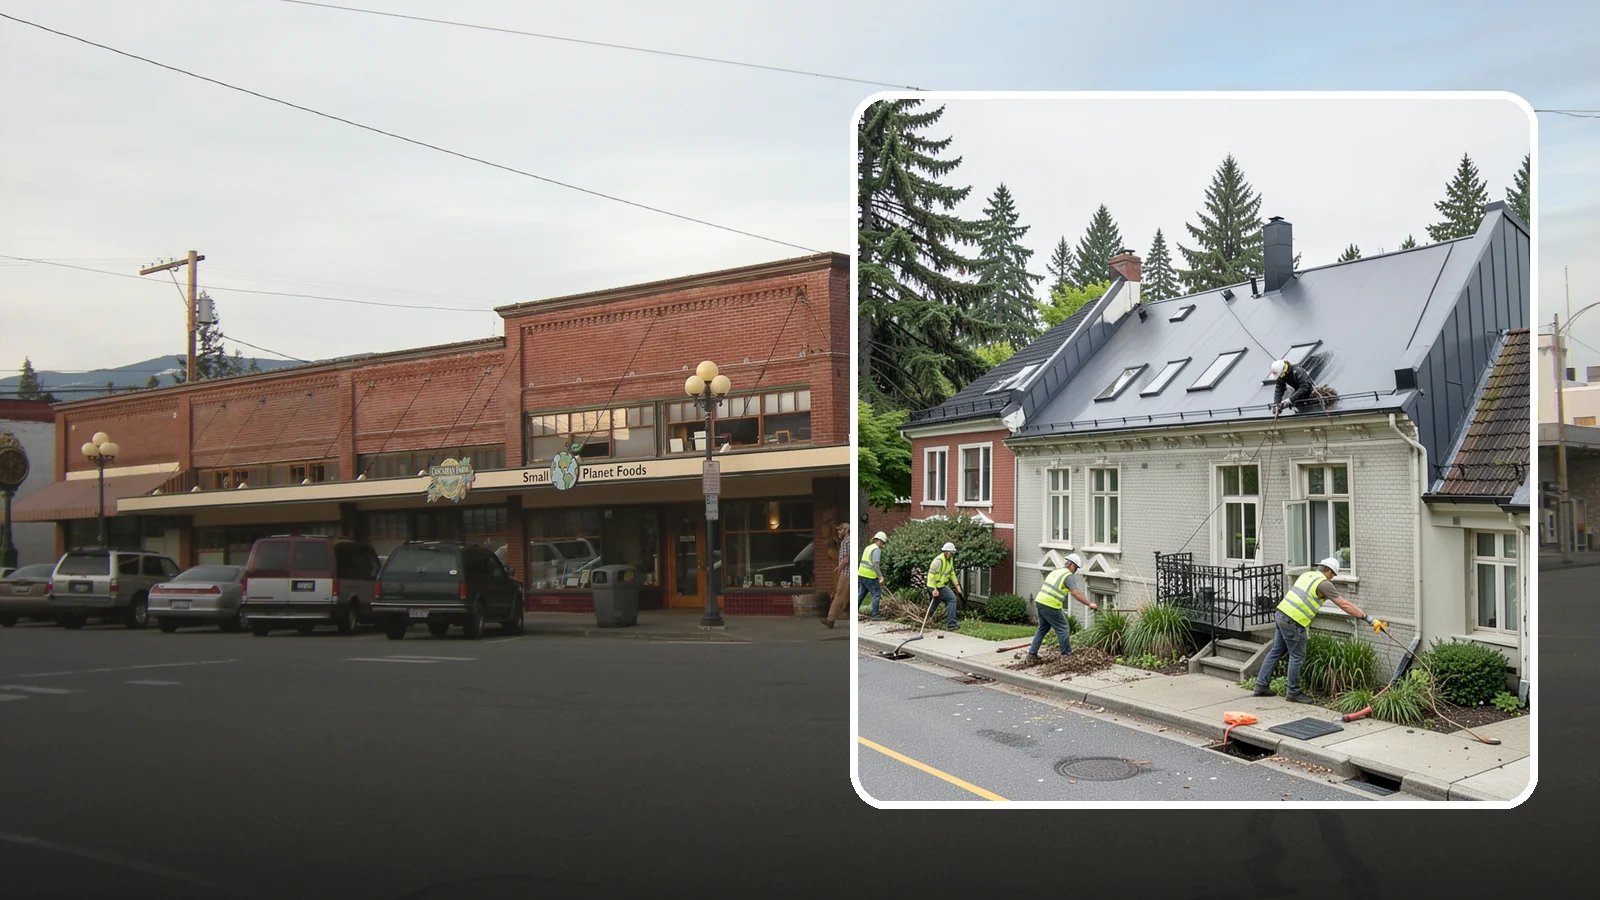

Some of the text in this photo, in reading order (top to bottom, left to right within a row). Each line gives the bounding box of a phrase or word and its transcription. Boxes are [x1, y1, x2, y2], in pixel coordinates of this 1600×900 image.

[523, 464, 647, 483] Small Planet Foods
